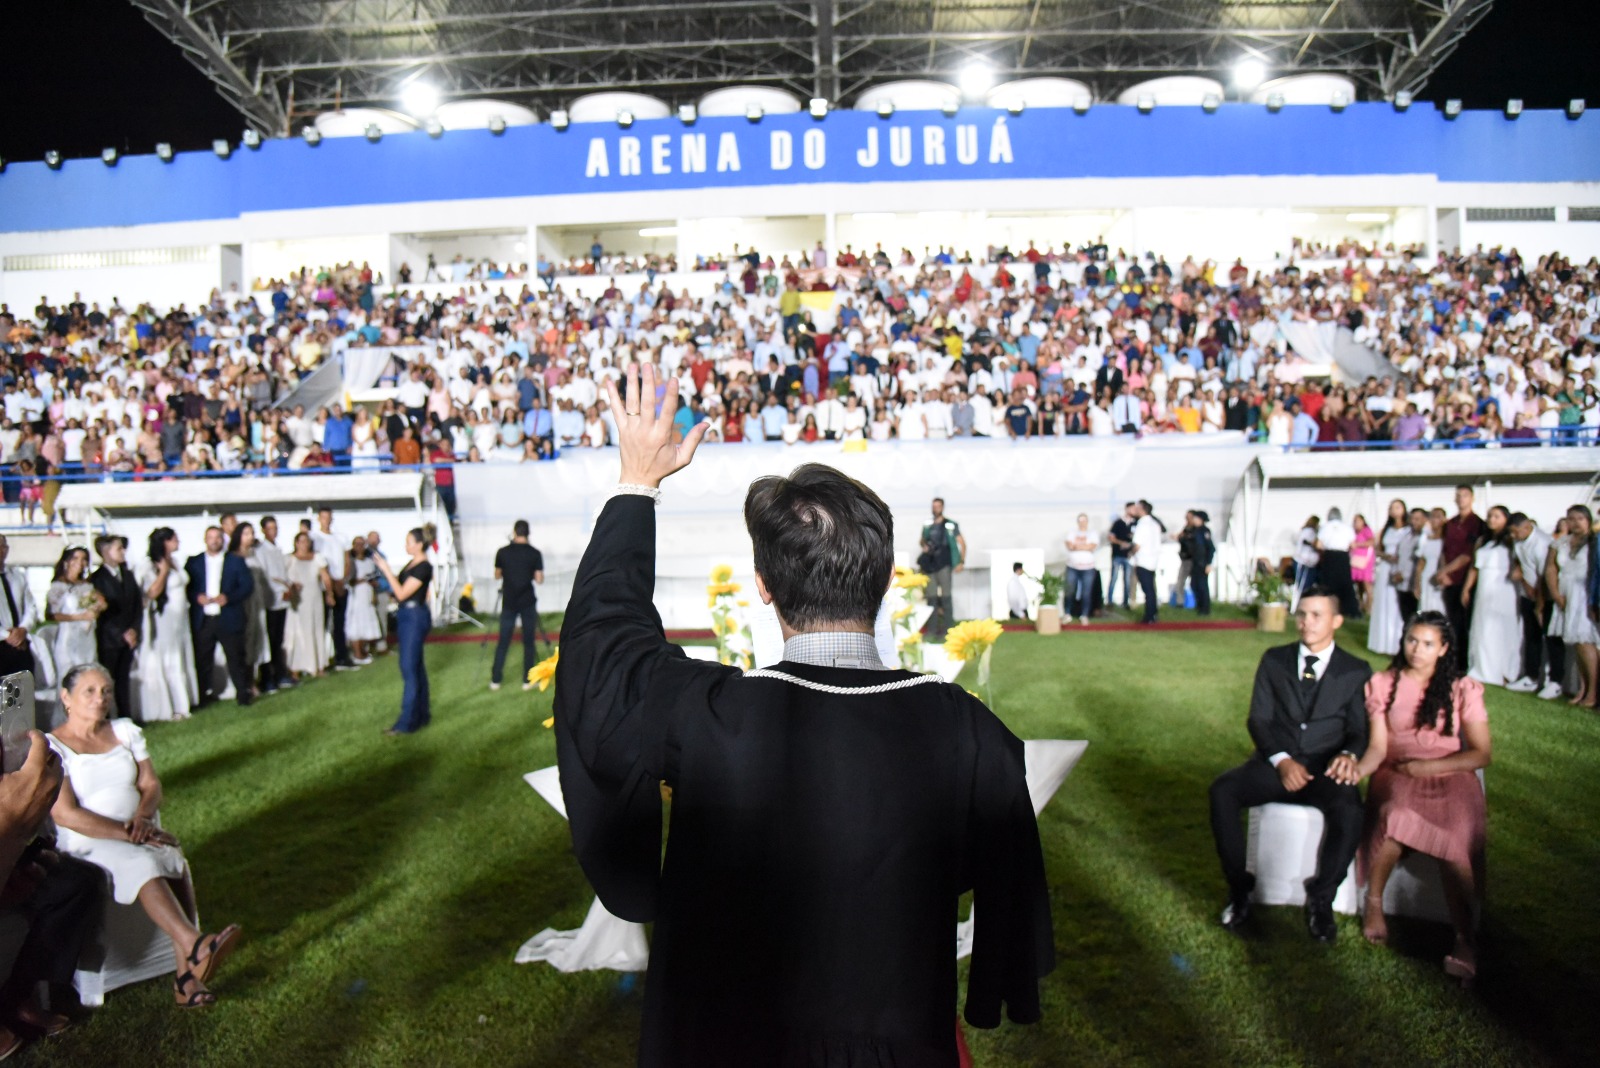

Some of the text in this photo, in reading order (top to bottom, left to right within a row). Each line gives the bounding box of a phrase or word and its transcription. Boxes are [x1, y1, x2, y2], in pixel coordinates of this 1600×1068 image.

[585, 115, 1015, 178] ARENA DO JURUÁ
